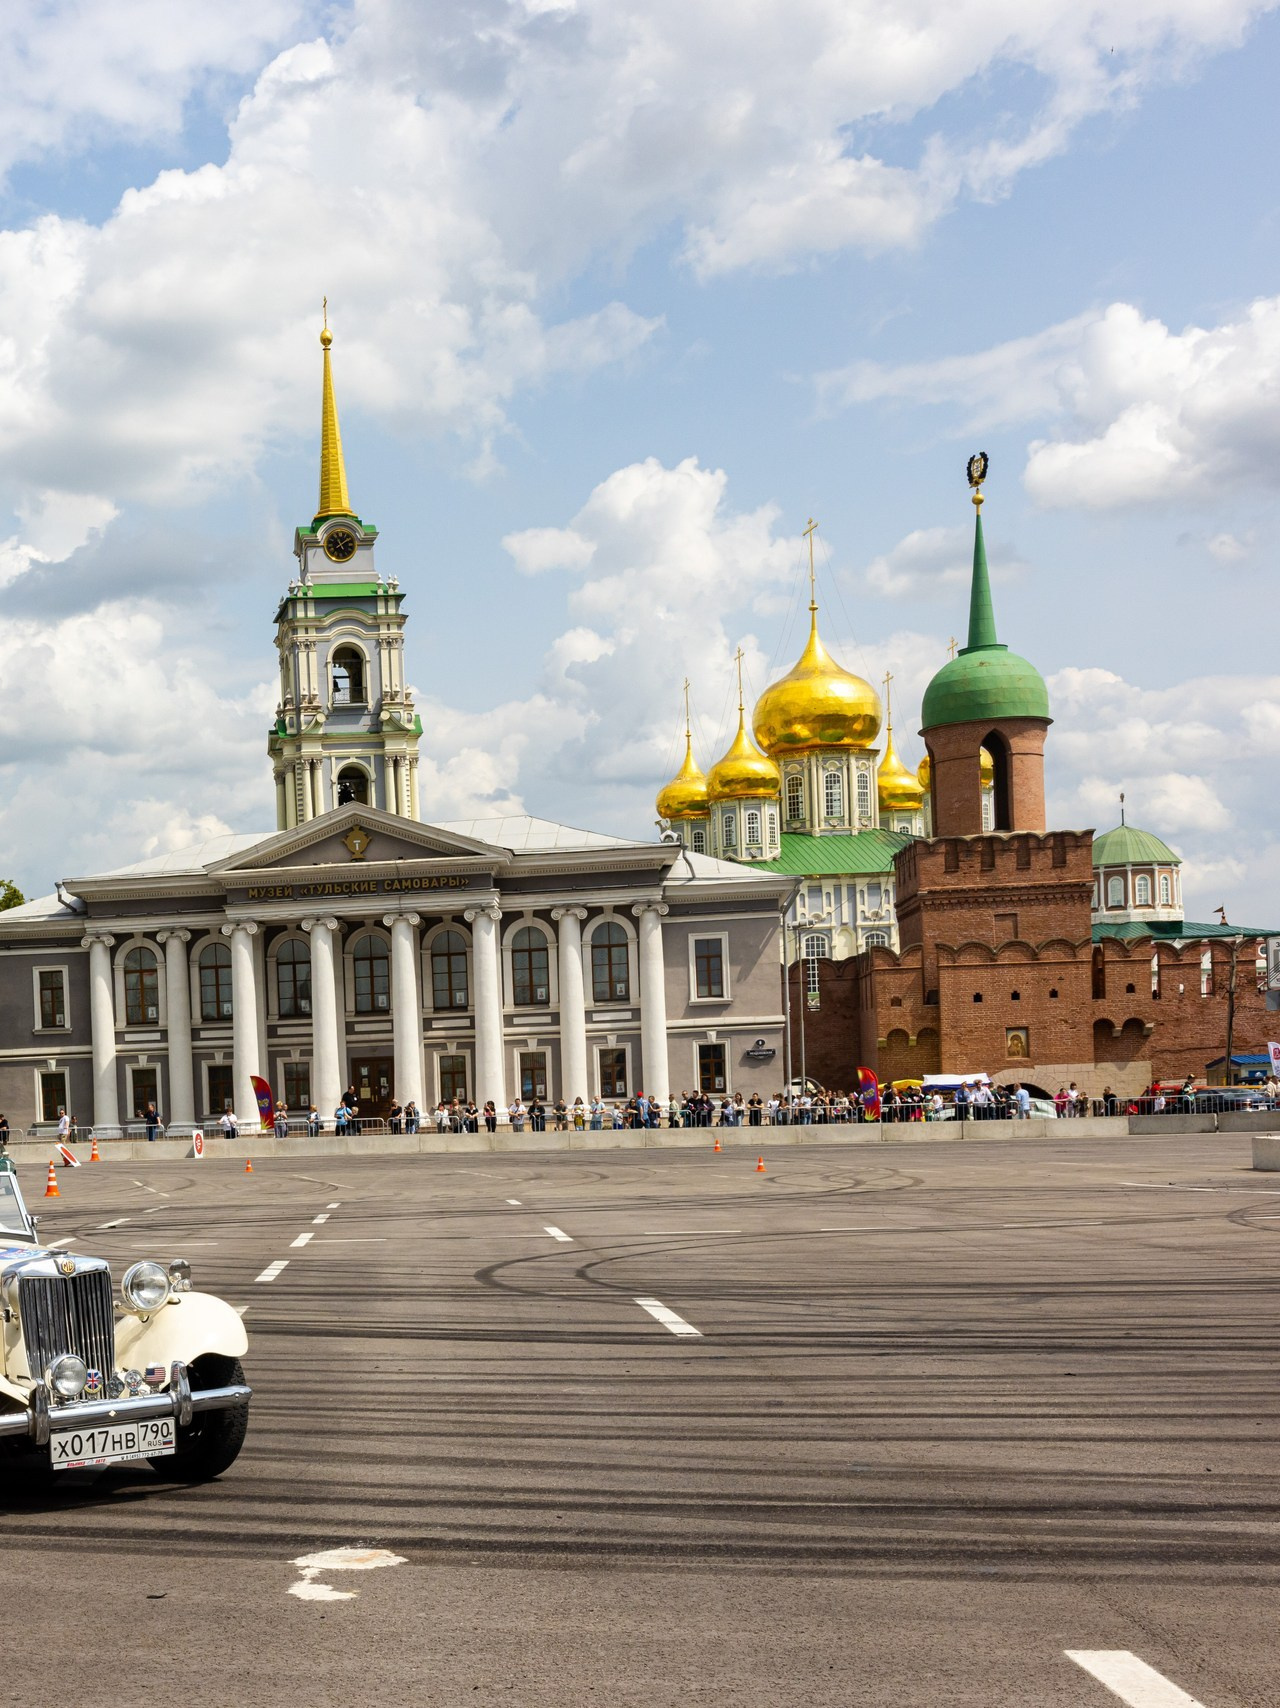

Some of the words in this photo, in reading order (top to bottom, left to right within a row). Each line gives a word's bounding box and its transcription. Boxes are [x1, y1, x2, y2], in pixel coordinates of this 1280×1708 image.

[248, 887, 293, 899] МУЗЕЙ
[300, 881, 377, 896] «ТУЛЬСКИЕ
[384, 876, 470, 891] САМОВАРЫ»
[140, 1422, 170, 1442] 790
[58, 1430, 136, 1459] Х017НВ
[147, 1440, 162, 1448] RUS
